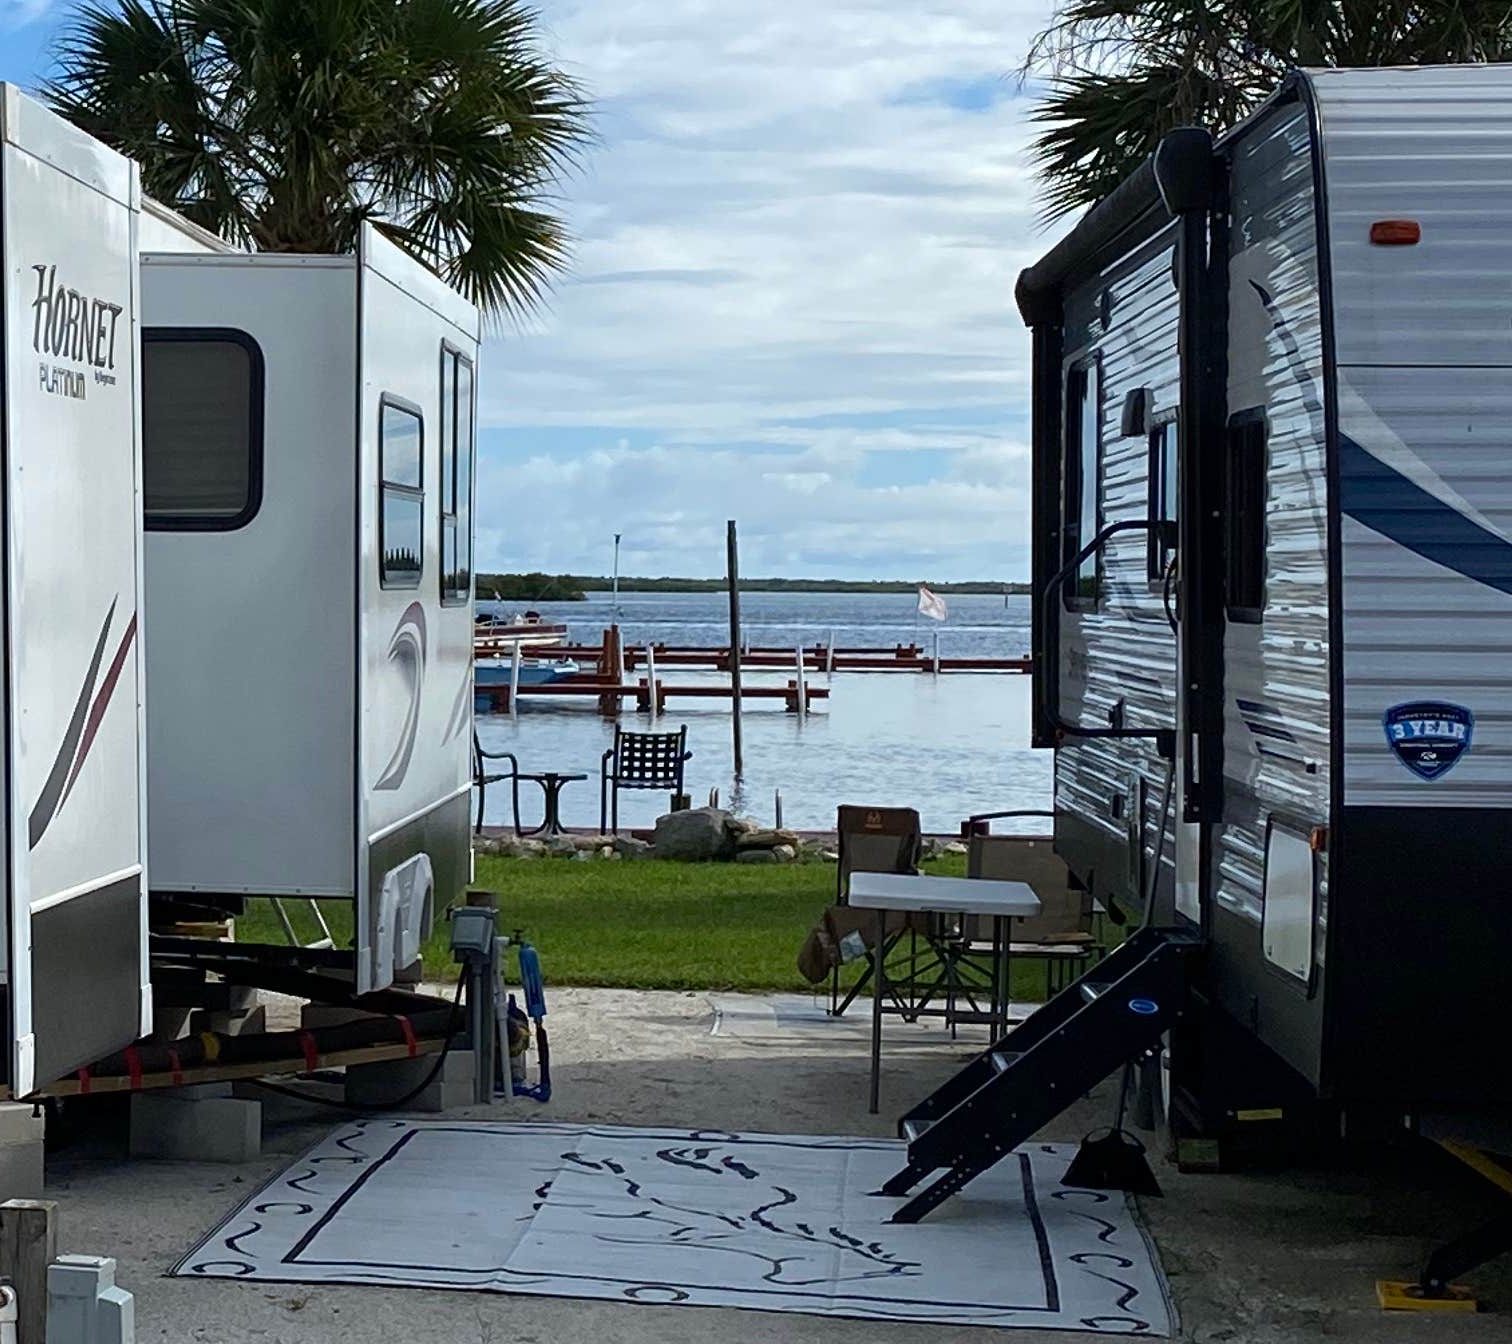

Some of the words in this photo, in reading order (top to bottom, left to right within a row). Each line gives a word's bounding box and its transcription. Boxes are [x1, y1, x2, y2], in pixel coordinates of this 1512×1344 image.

[32, 264, 123, 370] HORNET
[39, 362, 86, 400] PLATINUM
[1392, 723, 1405, 739] 3
[1409, 720, 1465, 739] YEAR
